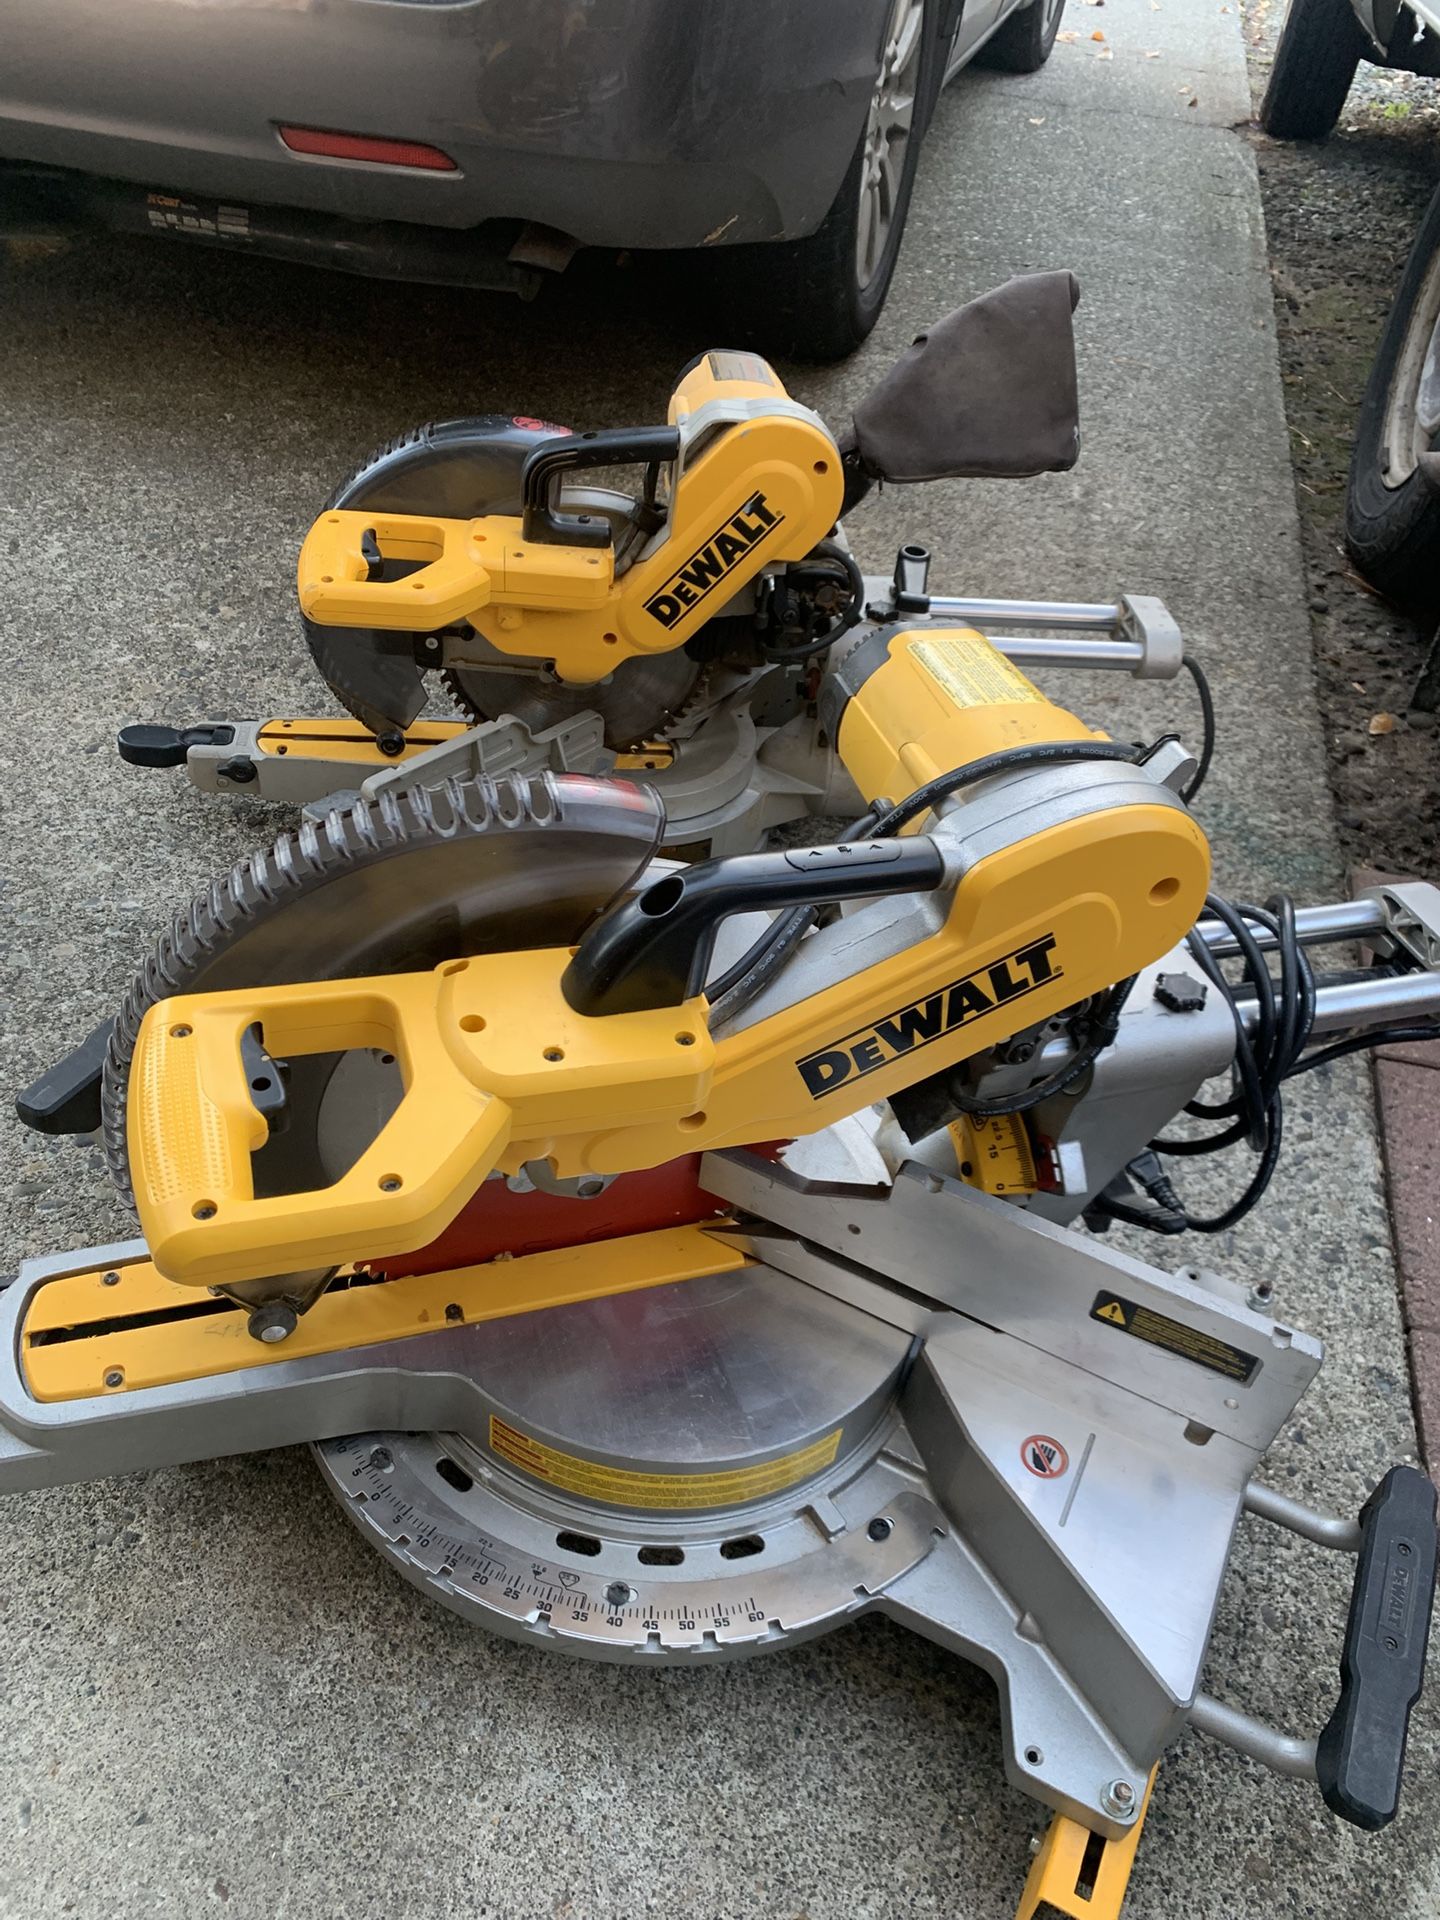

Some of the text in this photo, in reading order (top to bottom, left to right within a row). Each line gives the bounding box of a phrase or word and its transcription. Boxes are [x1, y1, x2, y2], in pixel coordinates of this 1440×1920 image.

[988, 1144, 999, 1159] 15
[996, 1183, 1005, 1191] 0
[352, 1467, 362, 1477] 5
[371, 1492, 381, 1502] 0
[393, 1514, 403, 1524] 5
[416, 1534, 430, 1548] 10
[444, 1554, 458, 1567] 15
[471, 1571, 489, 1586] 20
[503, 1587, 521, 1600] 25
[536, 1600, 553, 1612] 30
[571, 1611, 589, 1622] 35
[748, 1611, 765, 1623] 60
[606, 1617, 623, 1628] 40
[642, 1620, 659, 1631] 45
[679, 1620, 695, 1631] 50
[714, 1617, 731, 1628] 55
